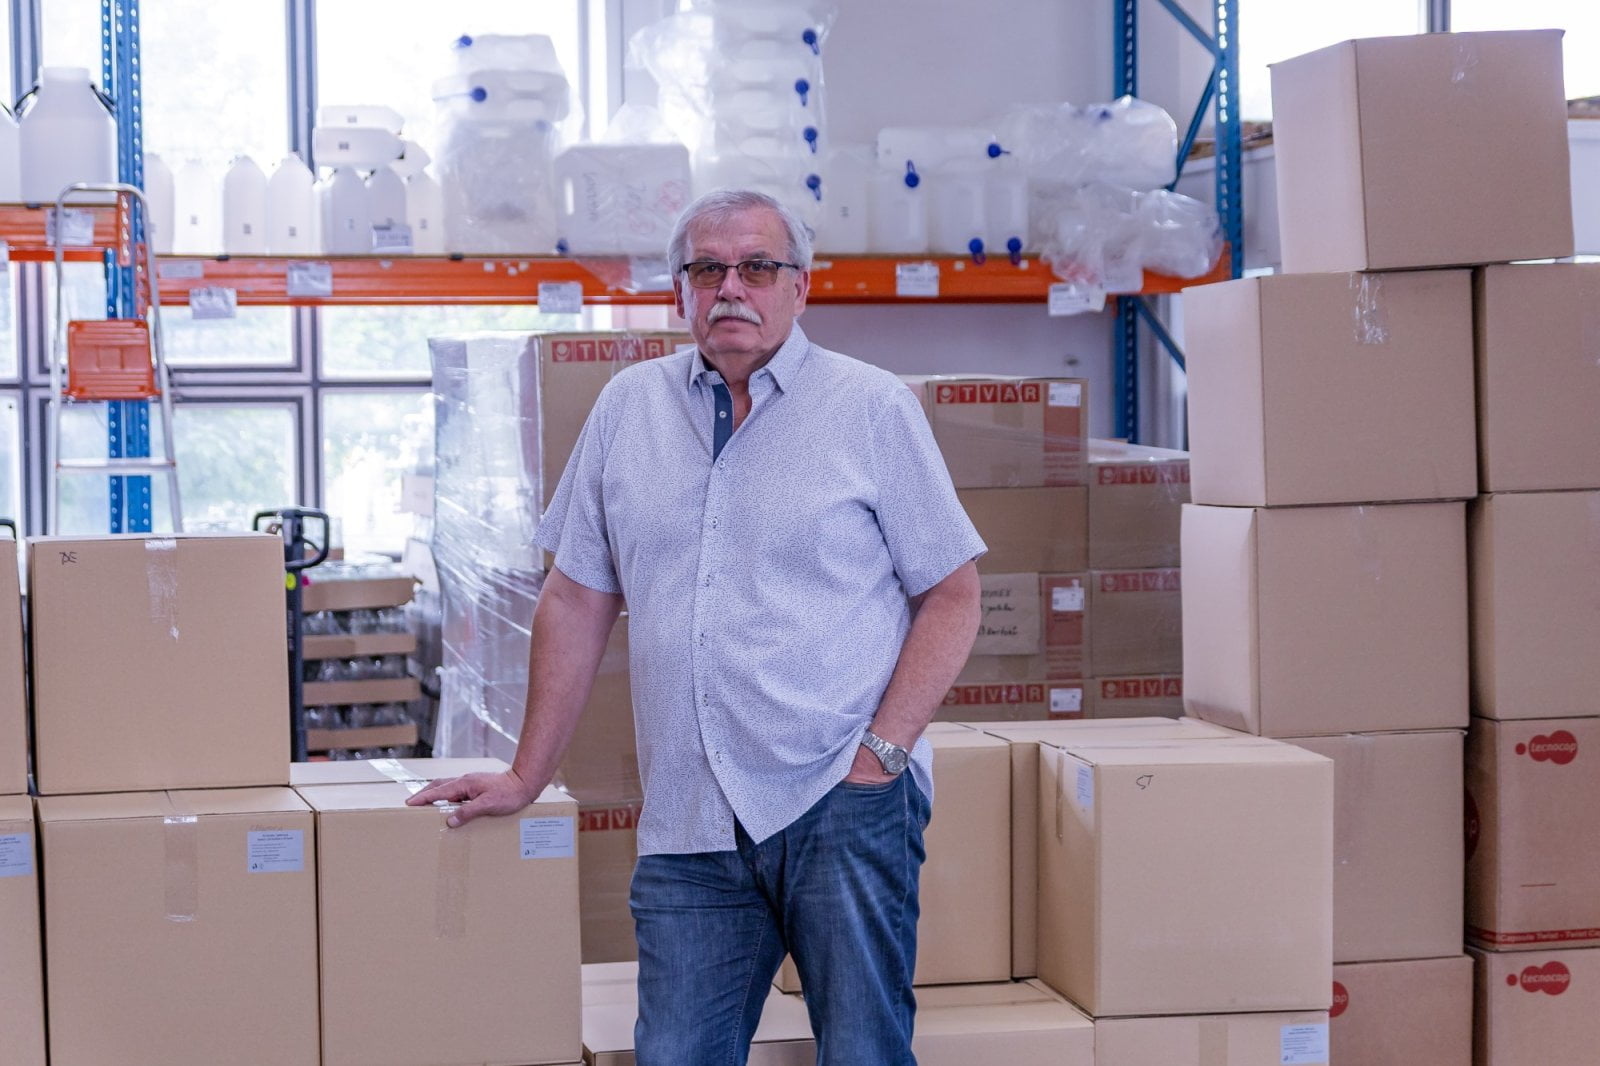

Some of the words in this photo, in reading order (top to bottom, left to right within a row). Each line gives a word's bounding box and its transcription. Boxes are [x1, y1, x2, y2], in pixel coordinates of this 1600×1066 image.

[578, 341, 662, 360] TVAR
[961, 385, 1039, 402] TVAR
[968, 685, 1044, 703] TVAR
[1530, 742, 1578, 754] tecnocap
[1521, 973, 1570, 985] tecnocap
